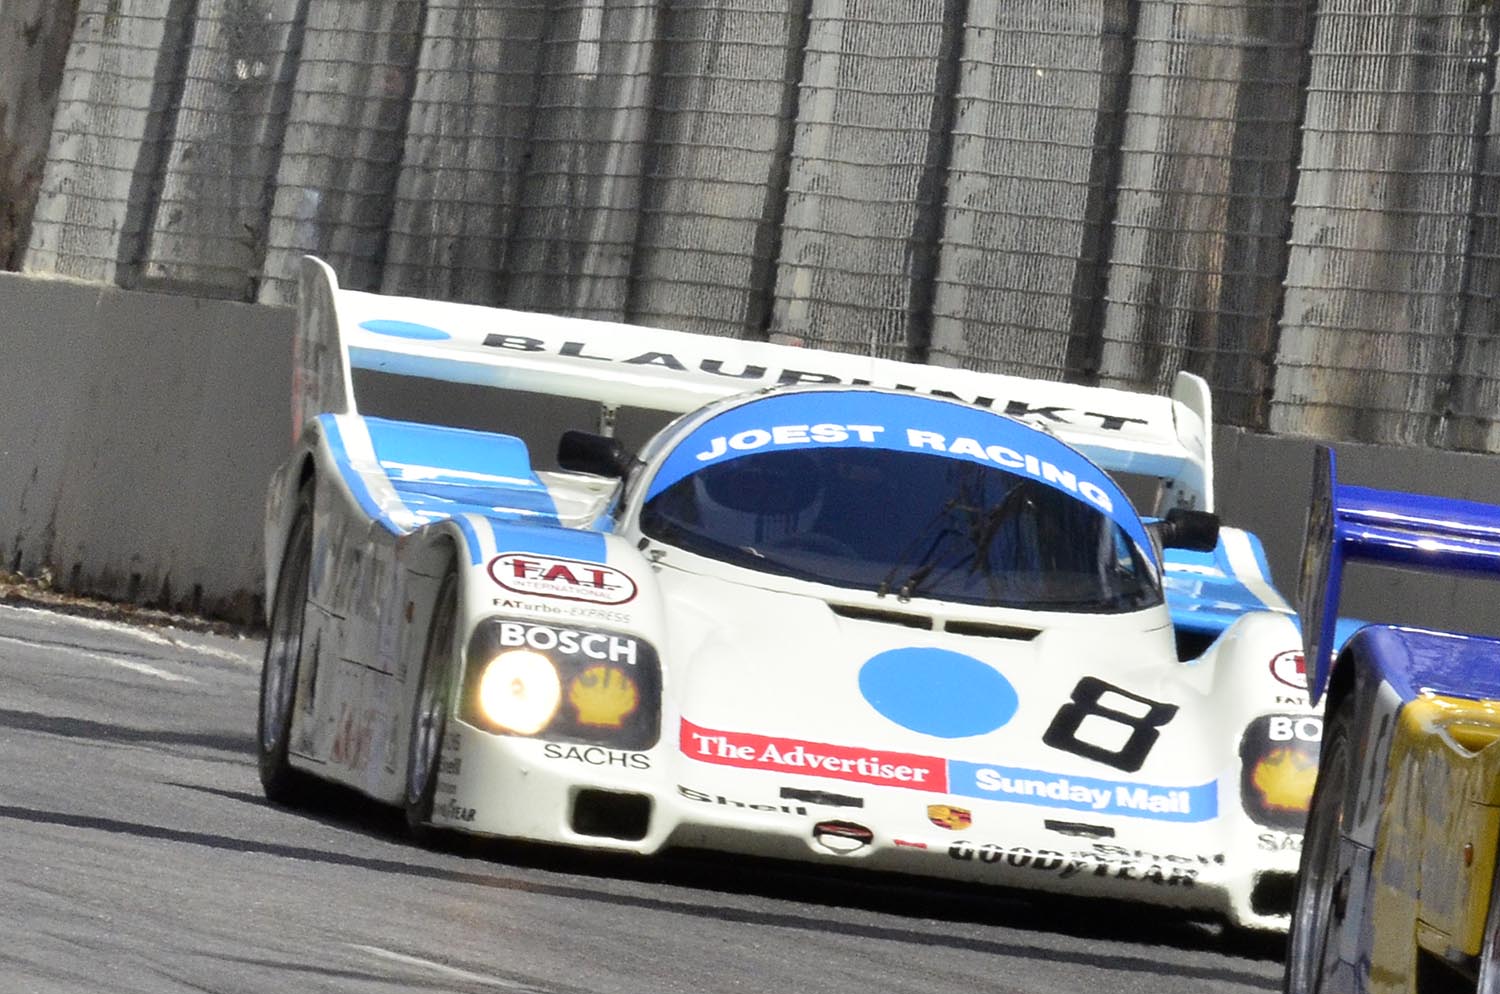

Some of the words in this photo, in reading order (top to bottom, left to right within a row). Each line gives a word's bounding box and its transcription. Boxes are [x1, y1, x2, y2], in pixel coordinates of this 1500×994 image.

[696, 424, 884, 462] JOEST
[906, 429, 1114, 513] RACING
[501, 623, 637, 664] BOSCH
[1042, 676, 1180, 773] 8
[544, 743, 650, 770] SACHS
[693, 733, 755, 761] The
[758, 744, 929, 782] Advertiser
[976, 769, 1112, 809] Sunday
[1116, 786, 1191, 814] Mail
